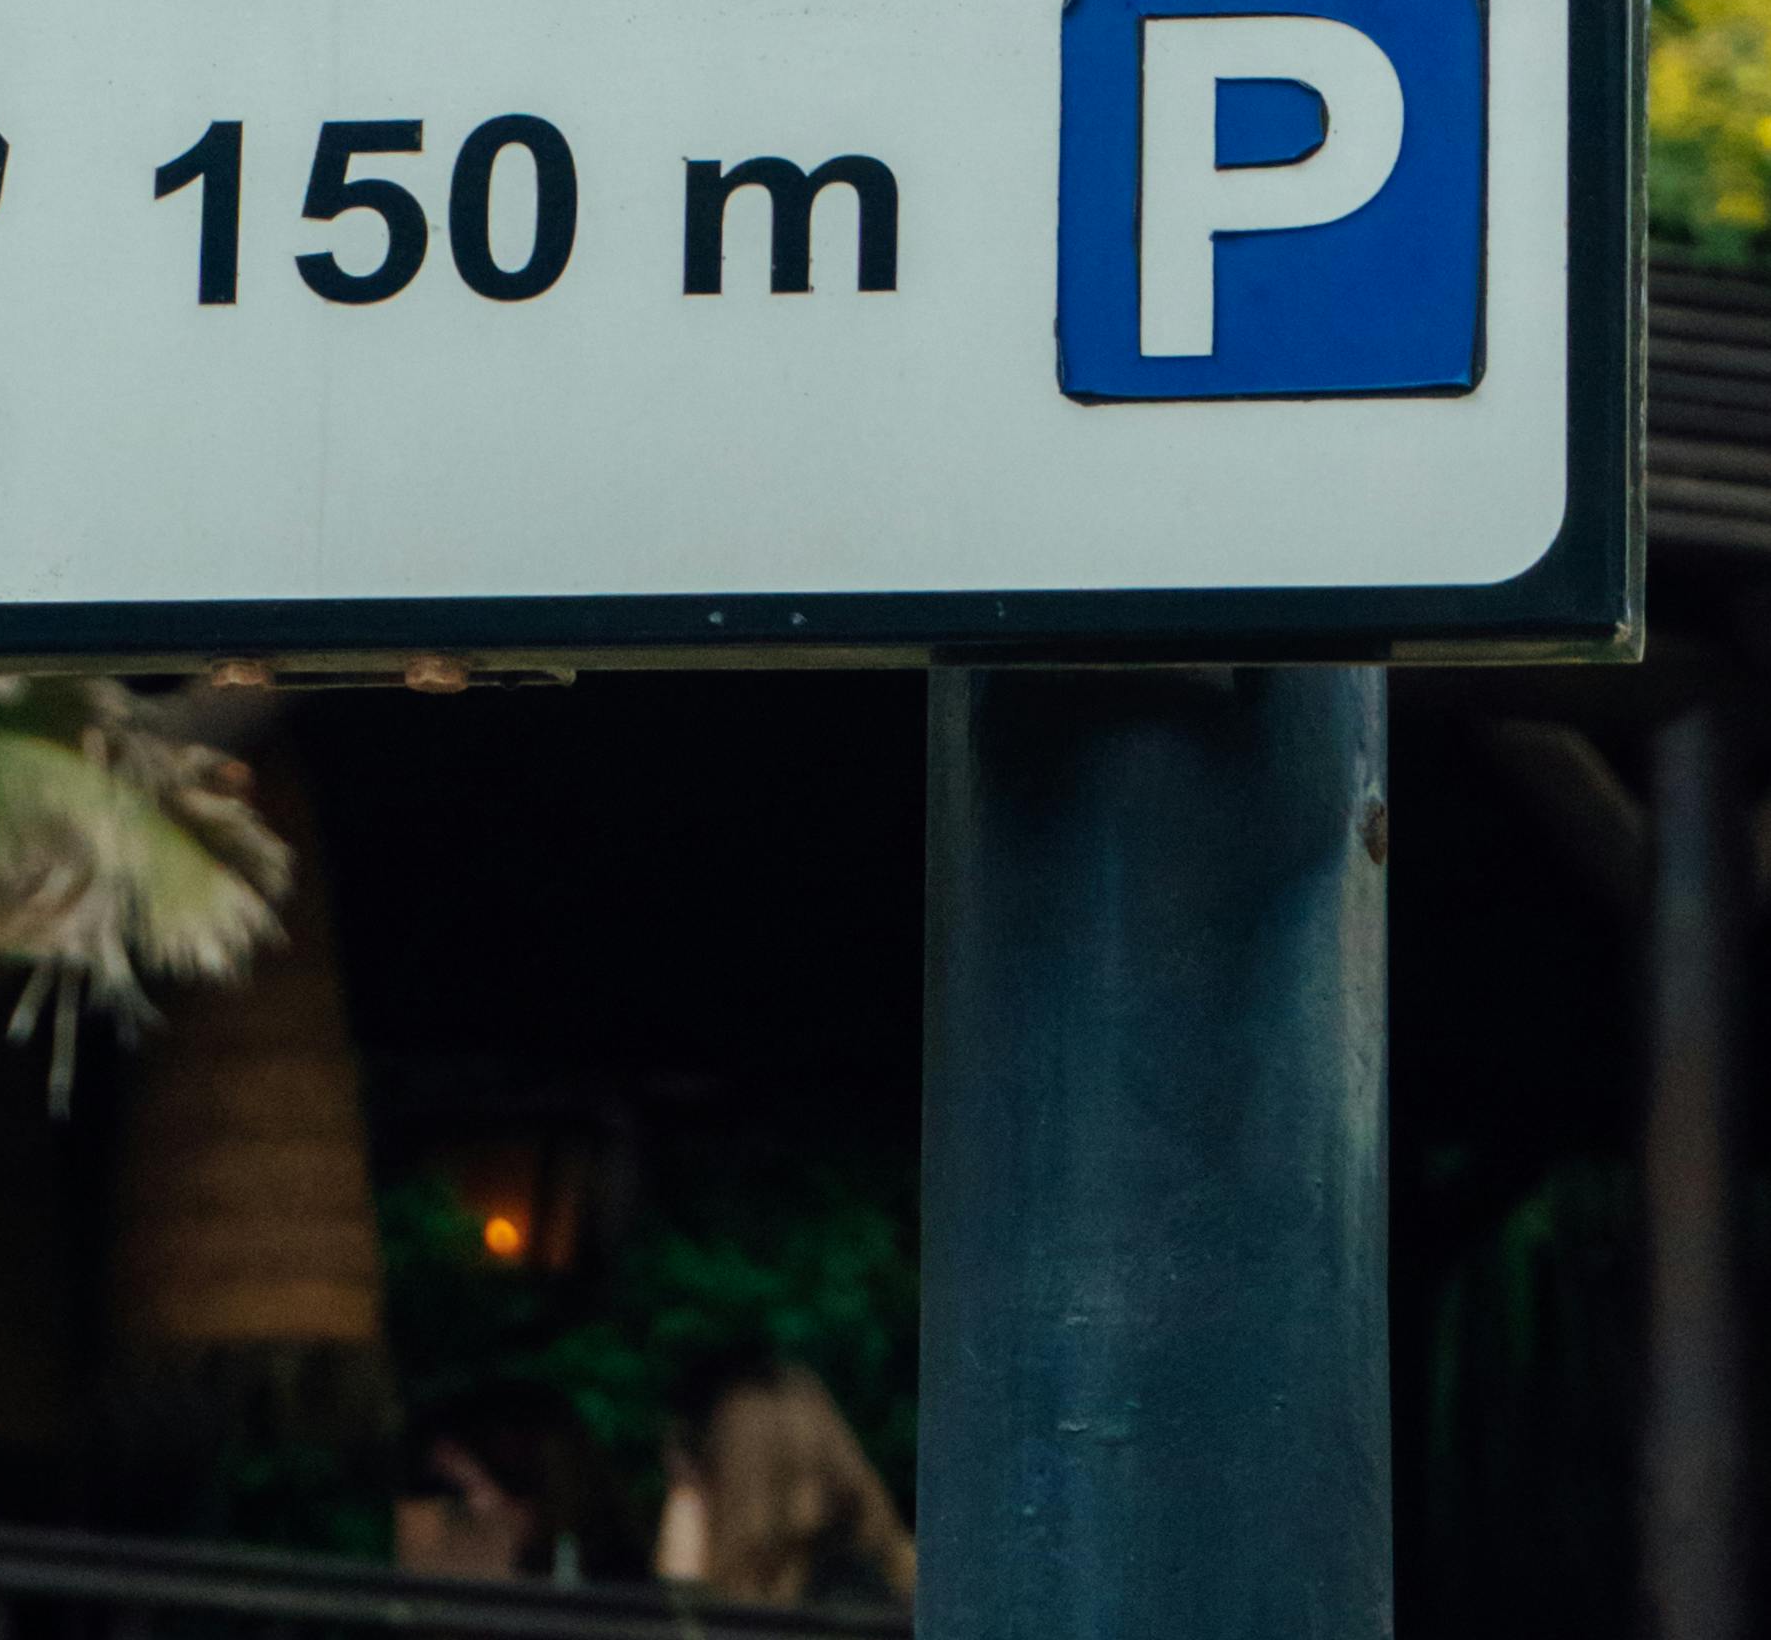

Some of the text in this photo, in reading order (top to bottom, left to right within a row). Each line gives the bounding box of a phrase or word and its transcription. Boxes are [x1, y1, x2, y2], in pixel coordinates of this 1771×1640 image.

[153, 113, 899, 306] 150 m
[1139, 16, 1405, 358] P
